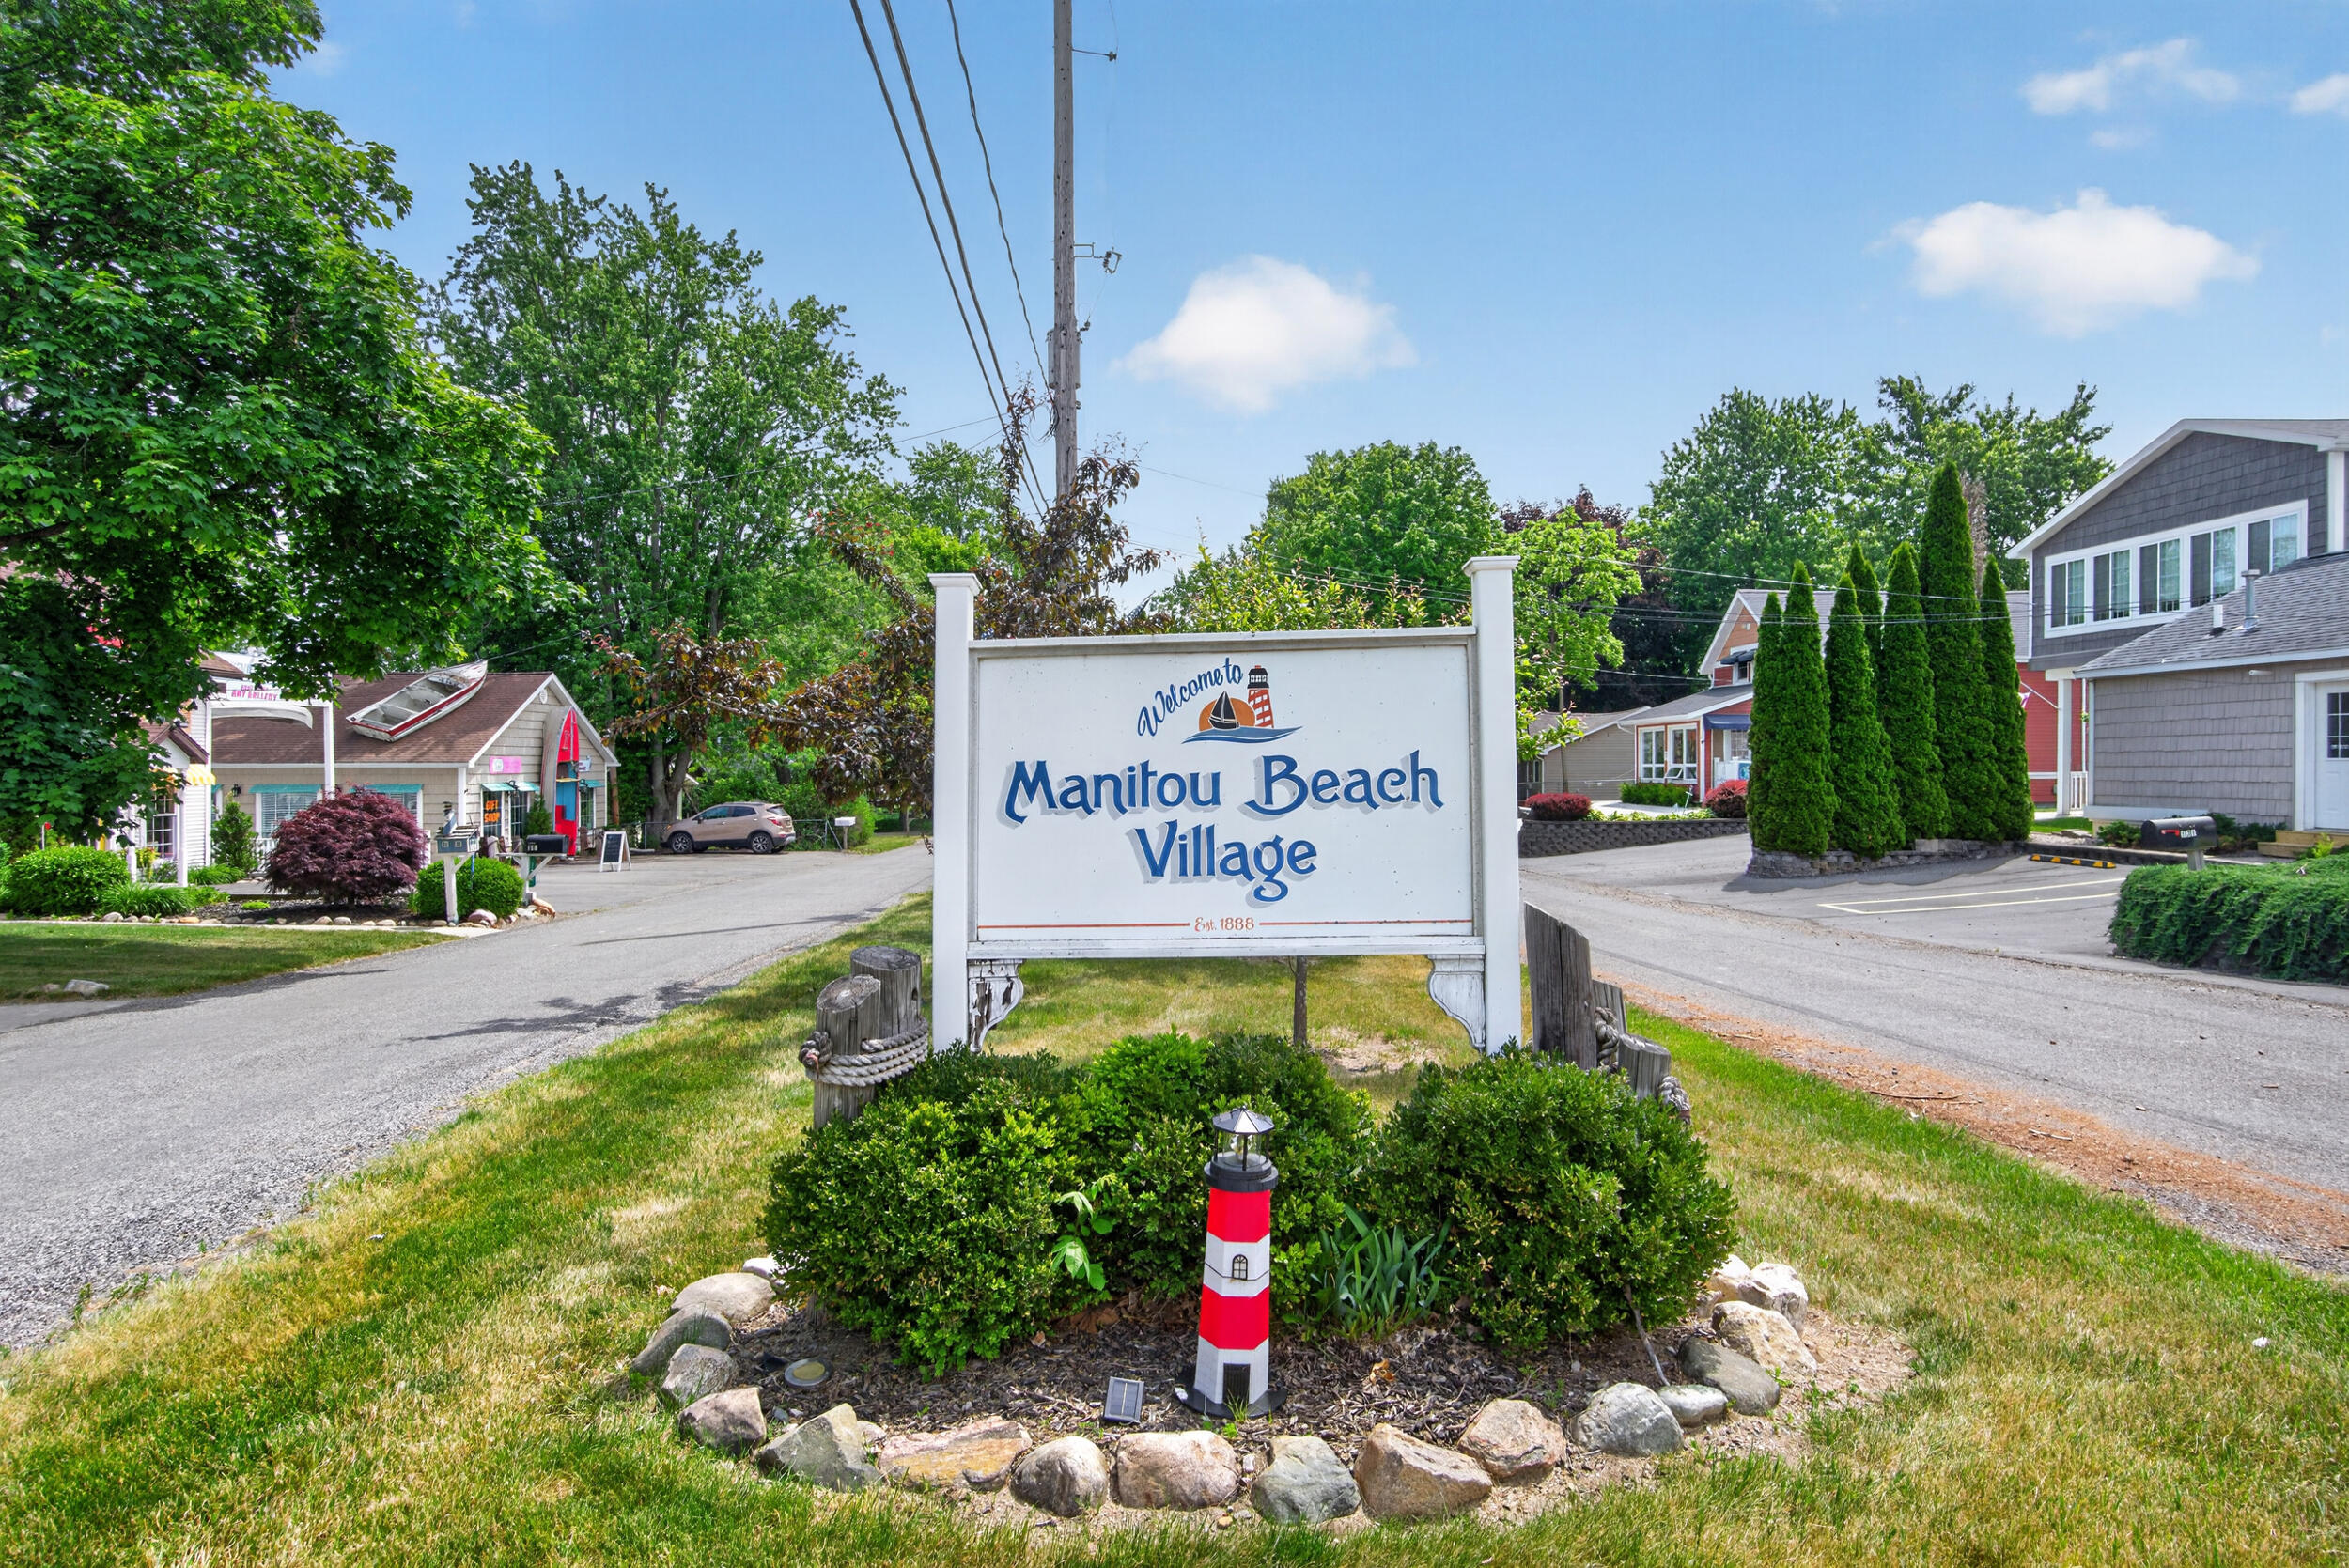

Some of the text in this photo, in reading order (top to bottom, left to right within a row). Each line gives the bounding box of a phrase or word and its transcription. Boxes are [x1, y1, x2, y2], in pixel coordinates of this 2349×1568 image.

[1137, 657, 1244, 737] Welcome to
[1004, 750, 1444, 824] Manitou Beach
[1134, 819, 1317, 903] Village
[1194, 916, 1254, 932] Est. 1888
